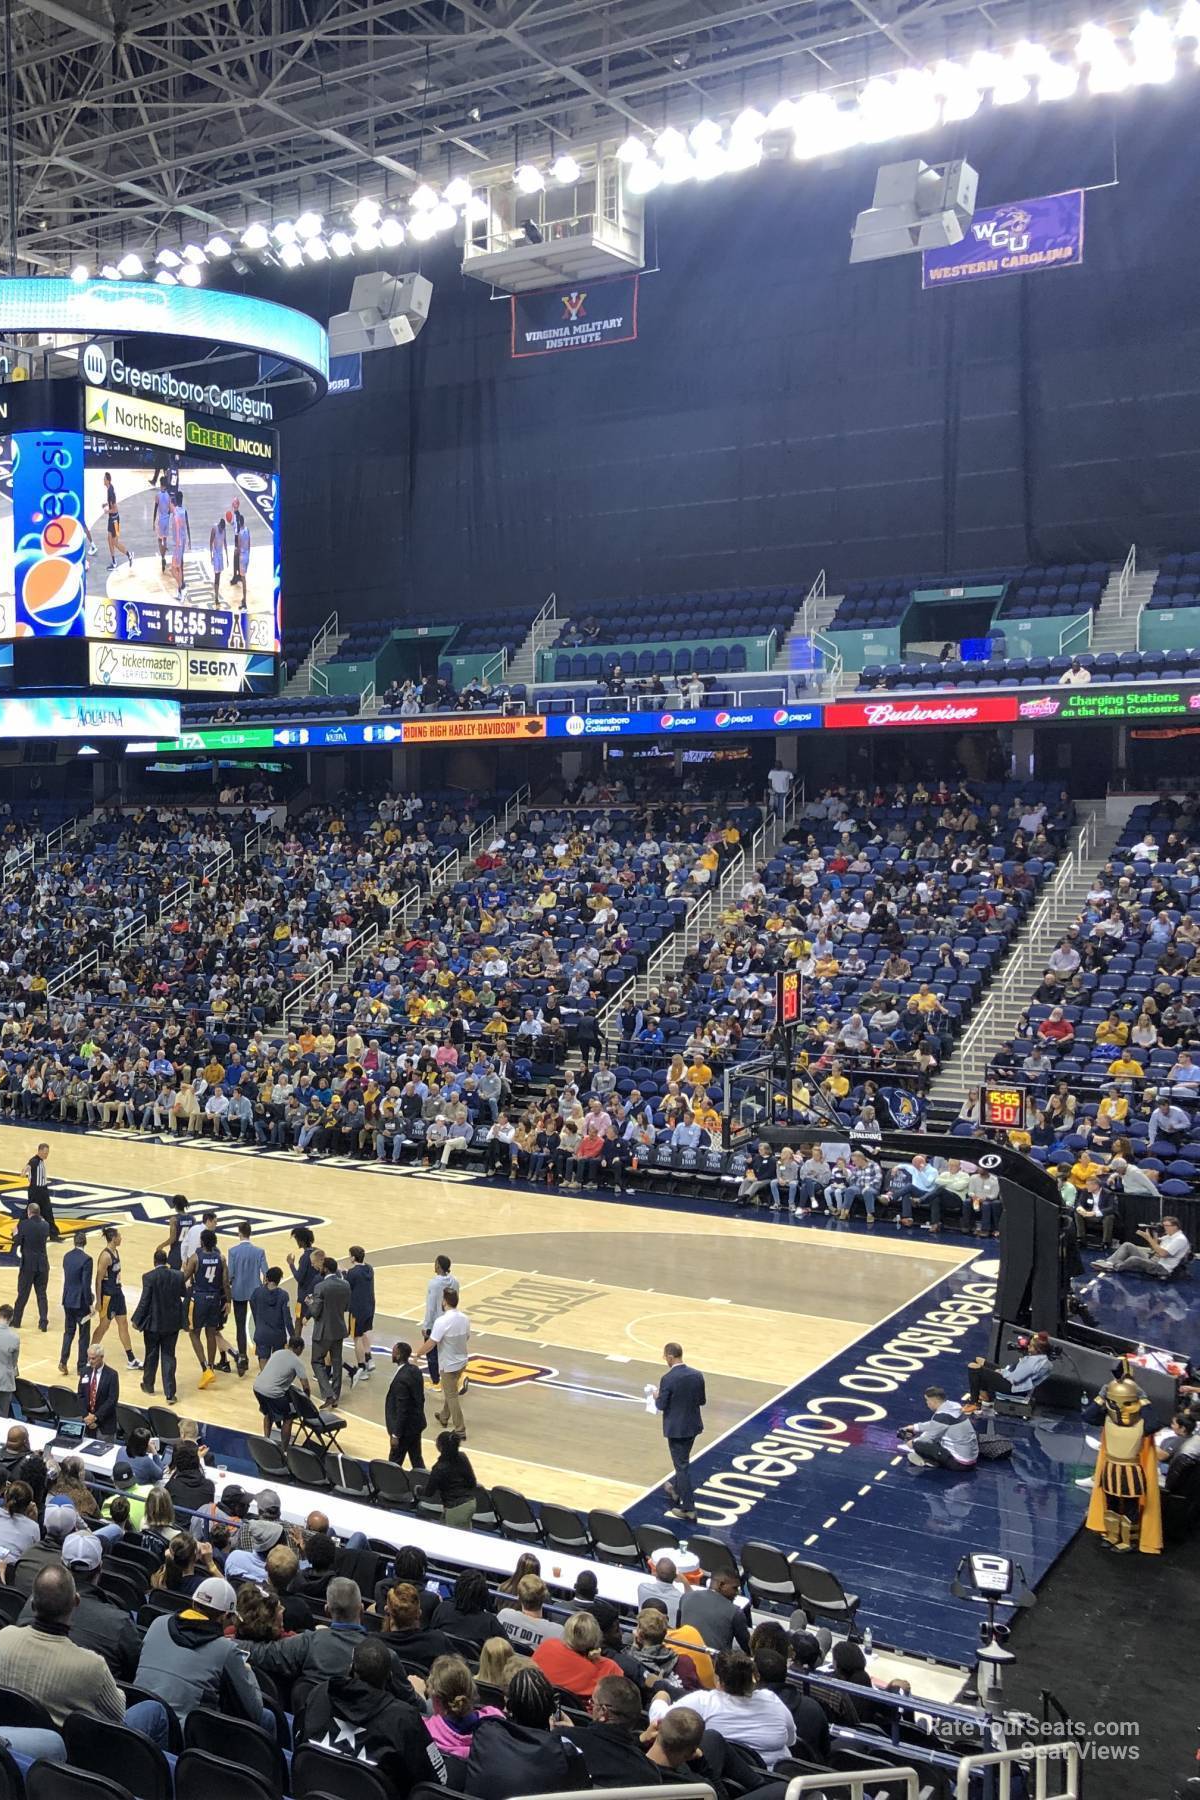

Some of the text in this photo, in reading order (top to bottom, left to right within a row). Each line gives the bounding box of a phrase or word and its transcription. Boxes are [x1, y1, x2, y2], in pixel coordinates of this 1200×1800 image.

[973, 222, 1029, 251] WCU
[929, 246, 1073, 280] WESTERN CAROLINA
[525, 316, 623, 343] VIRGINIA MILITARY
[546, 331, 601, 350] INSTITUTE
[111, 358, 273, 419] Greensboro Coliseum
[115, 406, 183, 439] NorthState
[187, 421, 271, 459] GREEN LINCOLN
[36, 441, 69, 549] pepsi
[94, 605, 117, 632] 43
[165, 611, 206, 635] 15:55
[250, 620, 269, 646] 28
[122, 653, 176, 670] ticketmaster
[190, 659, 238, 677] SEGRA
[150, 671, 173, 681] TICKETS
[1069, 696, 1124, 707] Charging
[1126, 693, 1179, 704] Stations
[77, 706, 123, 728] AQUAFINA
[730, 714, 753, 725] pepsi
[788, 712, 812, 723] pepsi
[864, 704, 978, 725] Budweiser
[1061, 704, 1186, 717] on the Main Concourse
[585, 716, 630, 726] Greensboro
[585, 723, 621, 733] Coliseum
[674, 716, 697, 727] pepsi
[403, 724, 427, 739] RIDING
[429, 723, 448, 738] HIGH
[989, 1091, 1020, 1105] 15:55
[992, 1107, 1016, 1123] 30
[849, 1131, 882, 1141] SPALDING
[205, 1266, 217, 1284] 4
[694, 1283, 997, 1526] Greensboro Coliseum
[520, 1629, 544, 1645] DO IT
